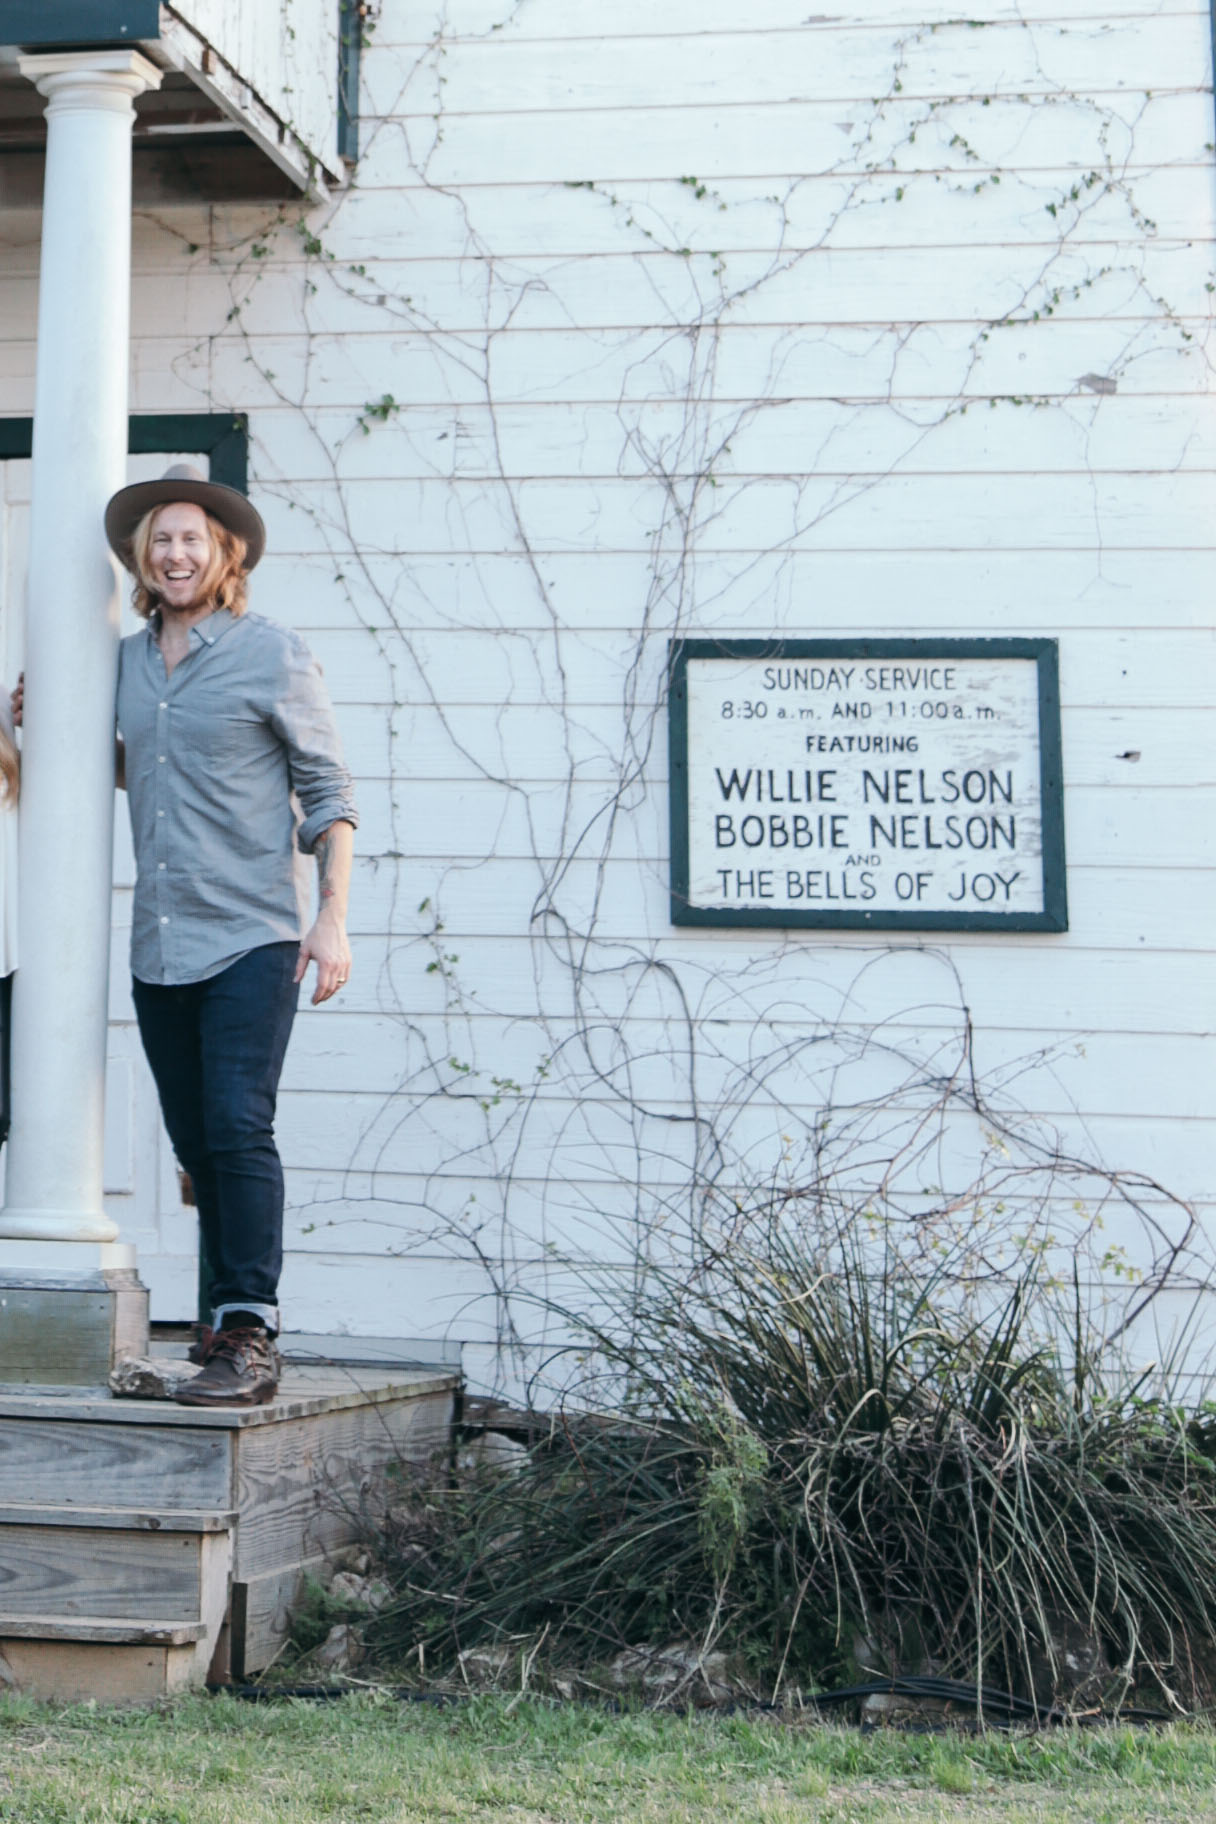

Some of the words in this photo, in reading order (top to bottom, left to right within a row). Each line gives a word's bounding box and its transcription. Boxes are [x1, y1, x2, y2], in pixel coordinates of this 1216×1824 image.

[763, 667, 856, 690] SUNDAY
[865, 667, 957, 690] SERVICE
[720, 700, 768, 720] 8:30
[776, 705, 822, 720] a.m.
[831, 701, 872, 719] AND
[806, 735, 919, 753] FEATURING
[714, 768, 838, 803] WILLIE
[863, 769, 1014, 804] NELSON
[715, 815, 850, 849] BOBBIE
[870, 815, 1017, 850] NELSON
[845, 854, 881, 867] AND
[717, 870, 774, 898] THE
[787, 871, 878, 900] BELLS
[895, 873, 934, 901] OF
[949, 872, 1021, 902] JOY
